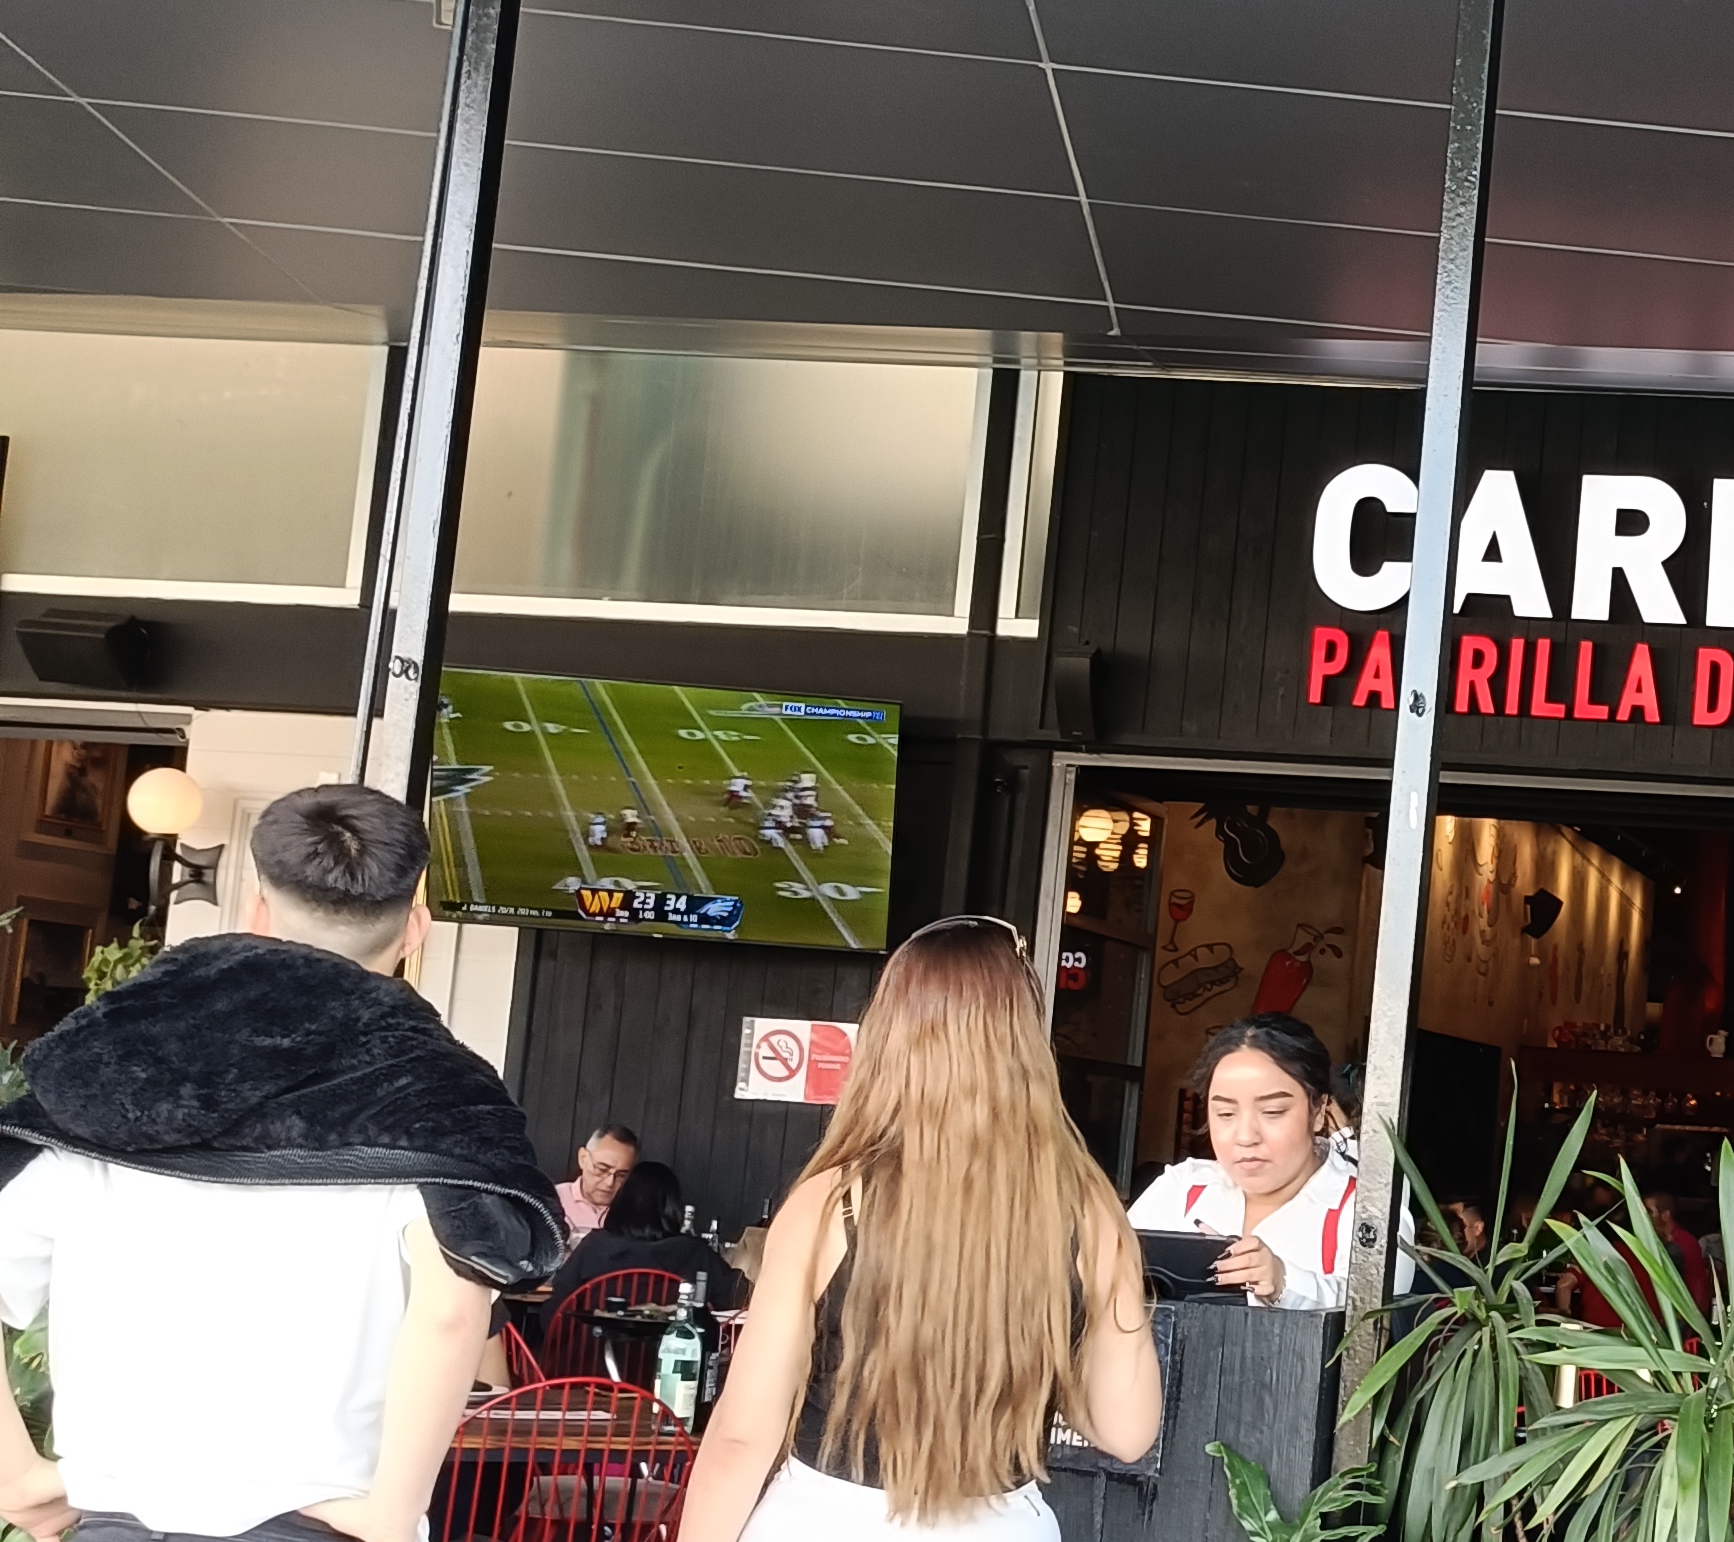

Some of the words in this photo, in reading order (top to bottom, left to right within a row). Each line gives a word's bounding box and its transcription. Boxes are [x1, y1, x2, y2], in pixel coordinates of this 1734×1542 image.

[1308, 626, 1660, 723] PARILLA
[632, 892, 656, 909] 23
[664, 894, 688, 912] 34
